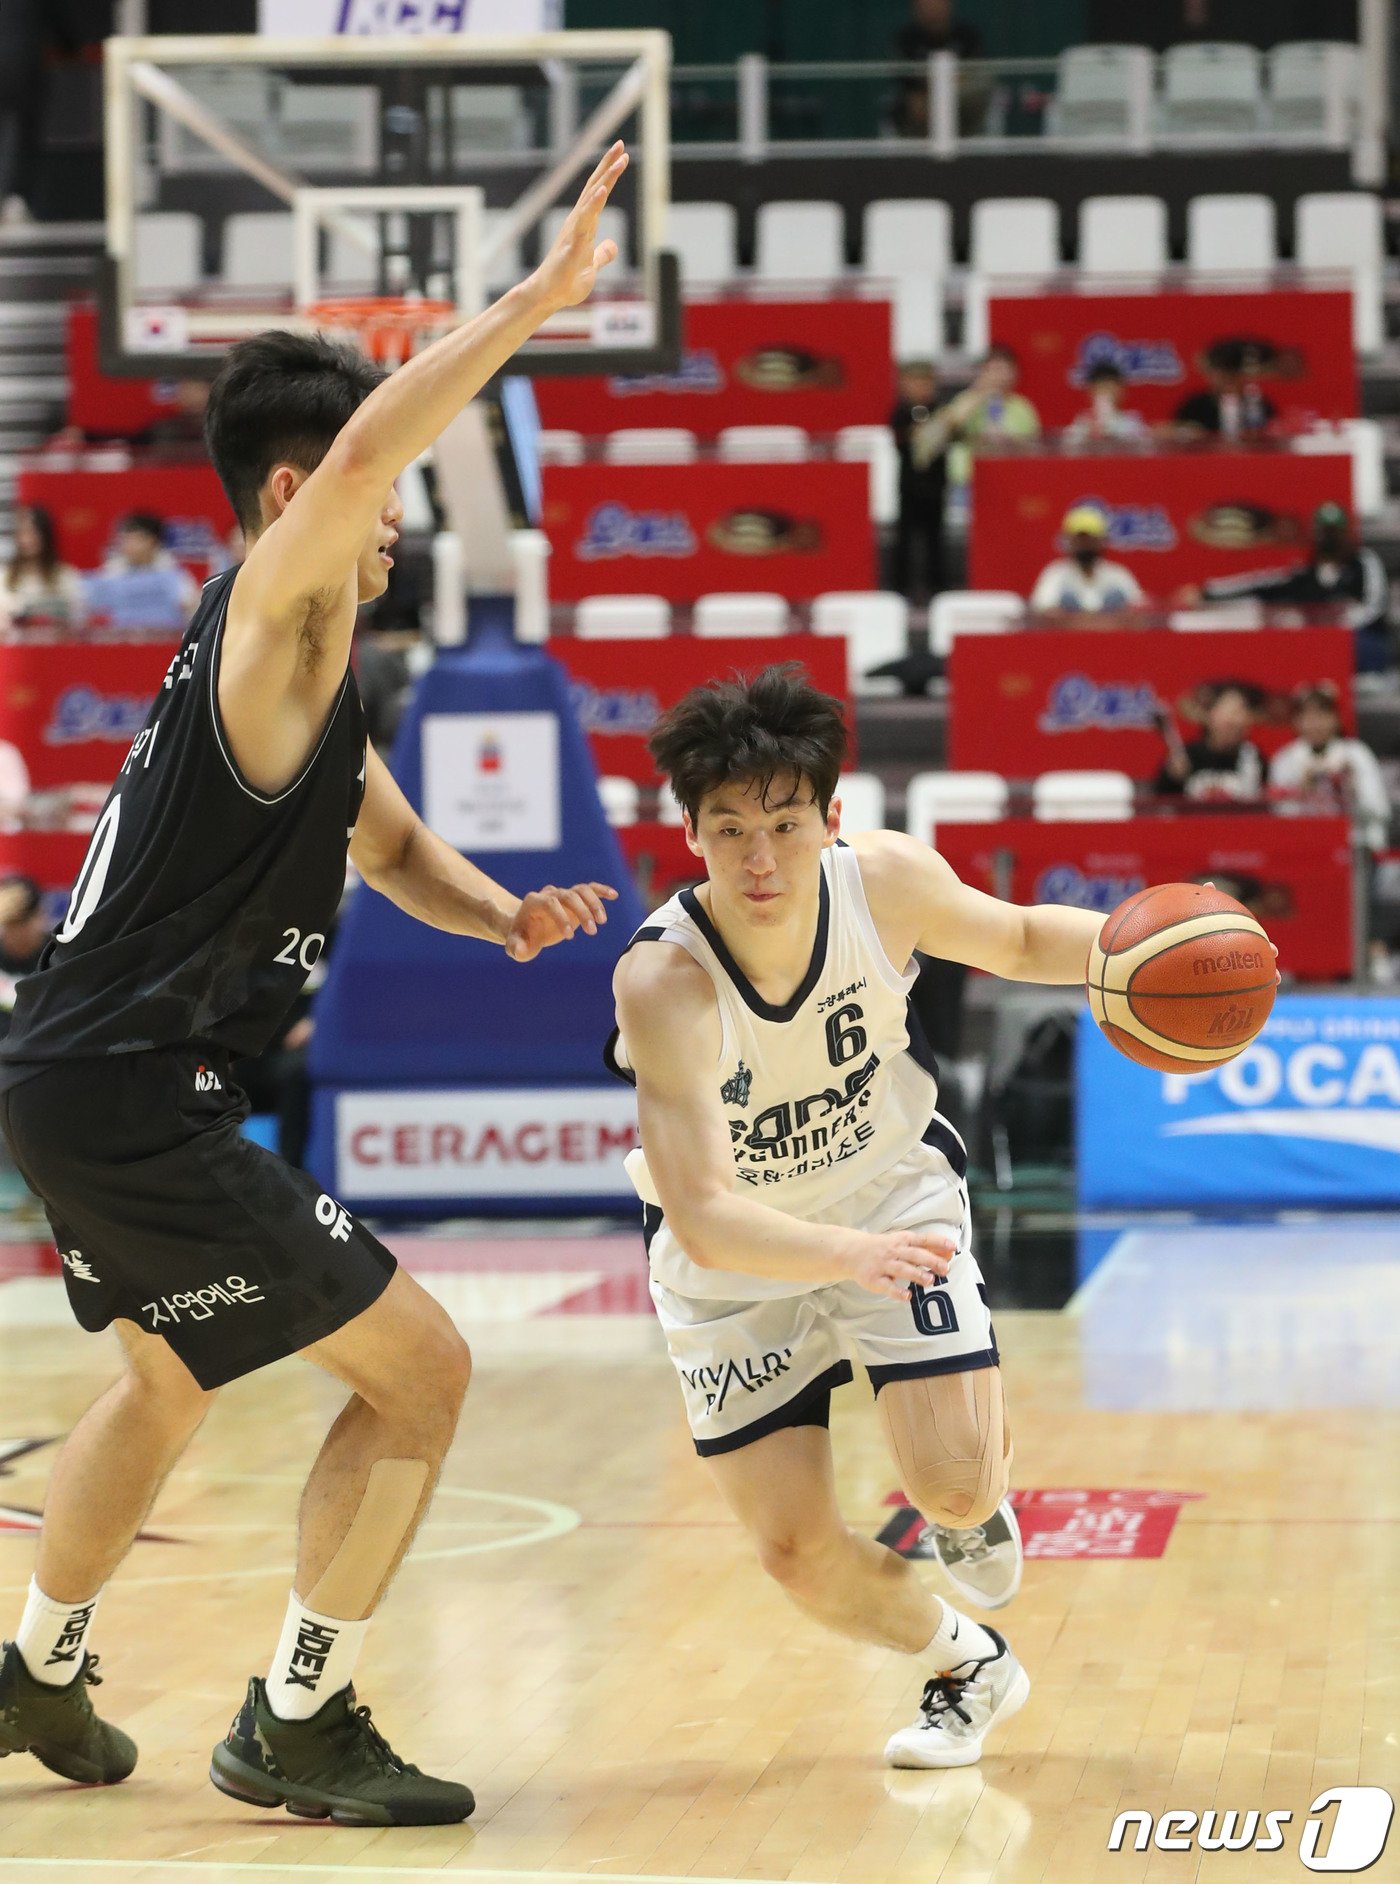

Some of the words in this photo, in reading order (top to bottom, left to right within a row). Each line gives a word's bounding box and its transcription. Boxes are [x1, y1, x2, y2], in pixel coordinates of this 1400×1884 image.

[1192, 951, 1264, 976] molten
[825, 1002, 867, 1067] 6
[350, 1121, 637, 1165] CERAGEM
[908, 1268, 960, 1335] 6
[43, 1602, 96, 1666] HDEX
[284, 1617, 339, 1692] HDEX
